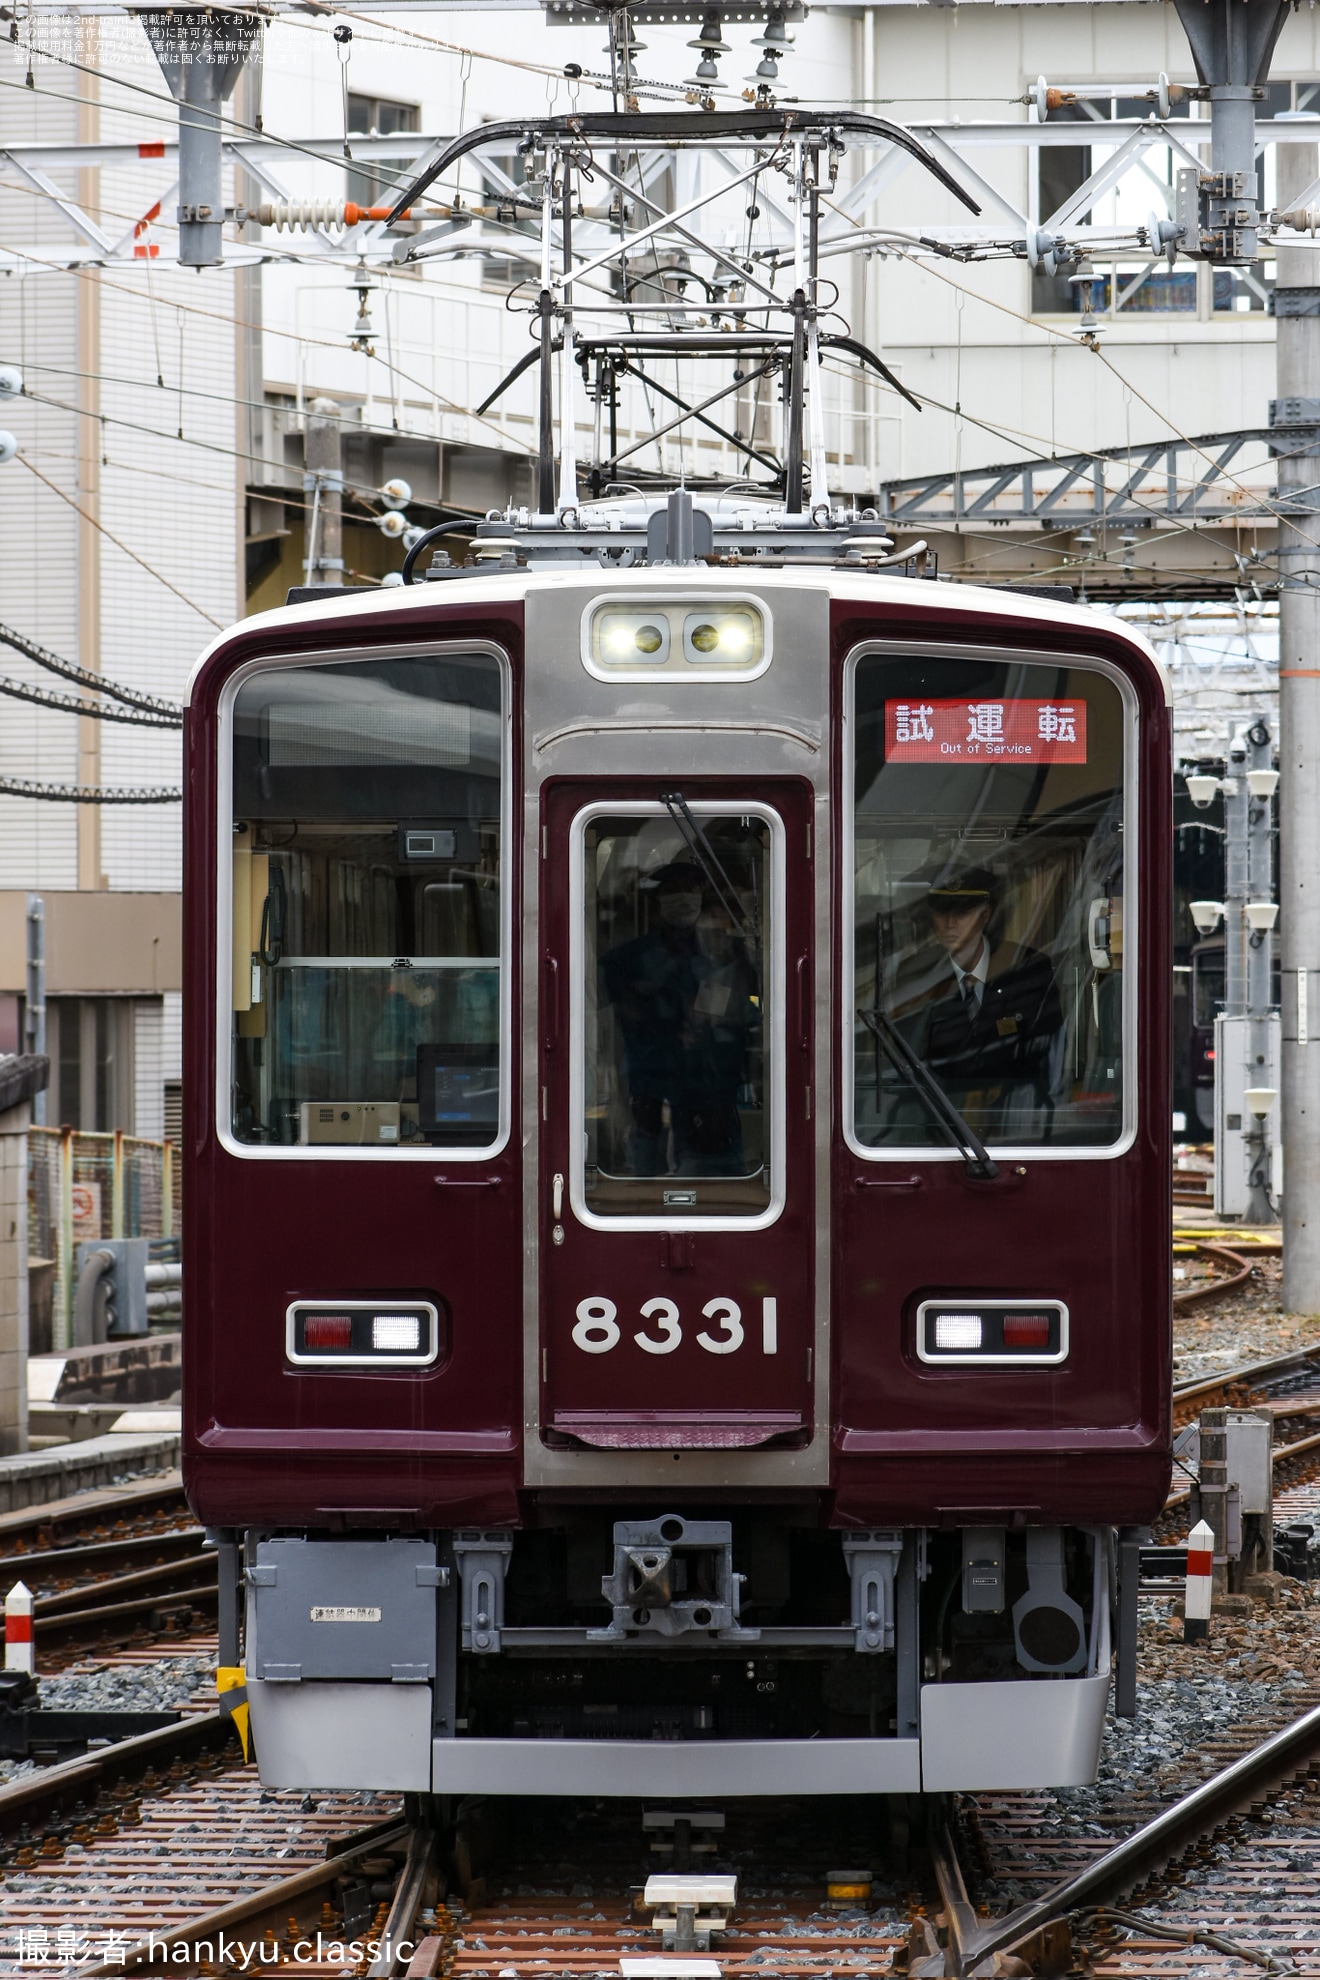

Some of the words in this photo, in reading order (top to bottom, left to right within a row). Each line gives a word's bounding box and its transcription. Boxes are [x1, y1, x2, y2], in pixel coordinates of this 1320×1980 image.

[895, 704, 1076, 742] 試運転
[940, 742, 962, 754] Out
[967, 742, 981, 754] of
[985, 742, 1032, 754] Service
[571, 1296, 777, 1355] 8331
